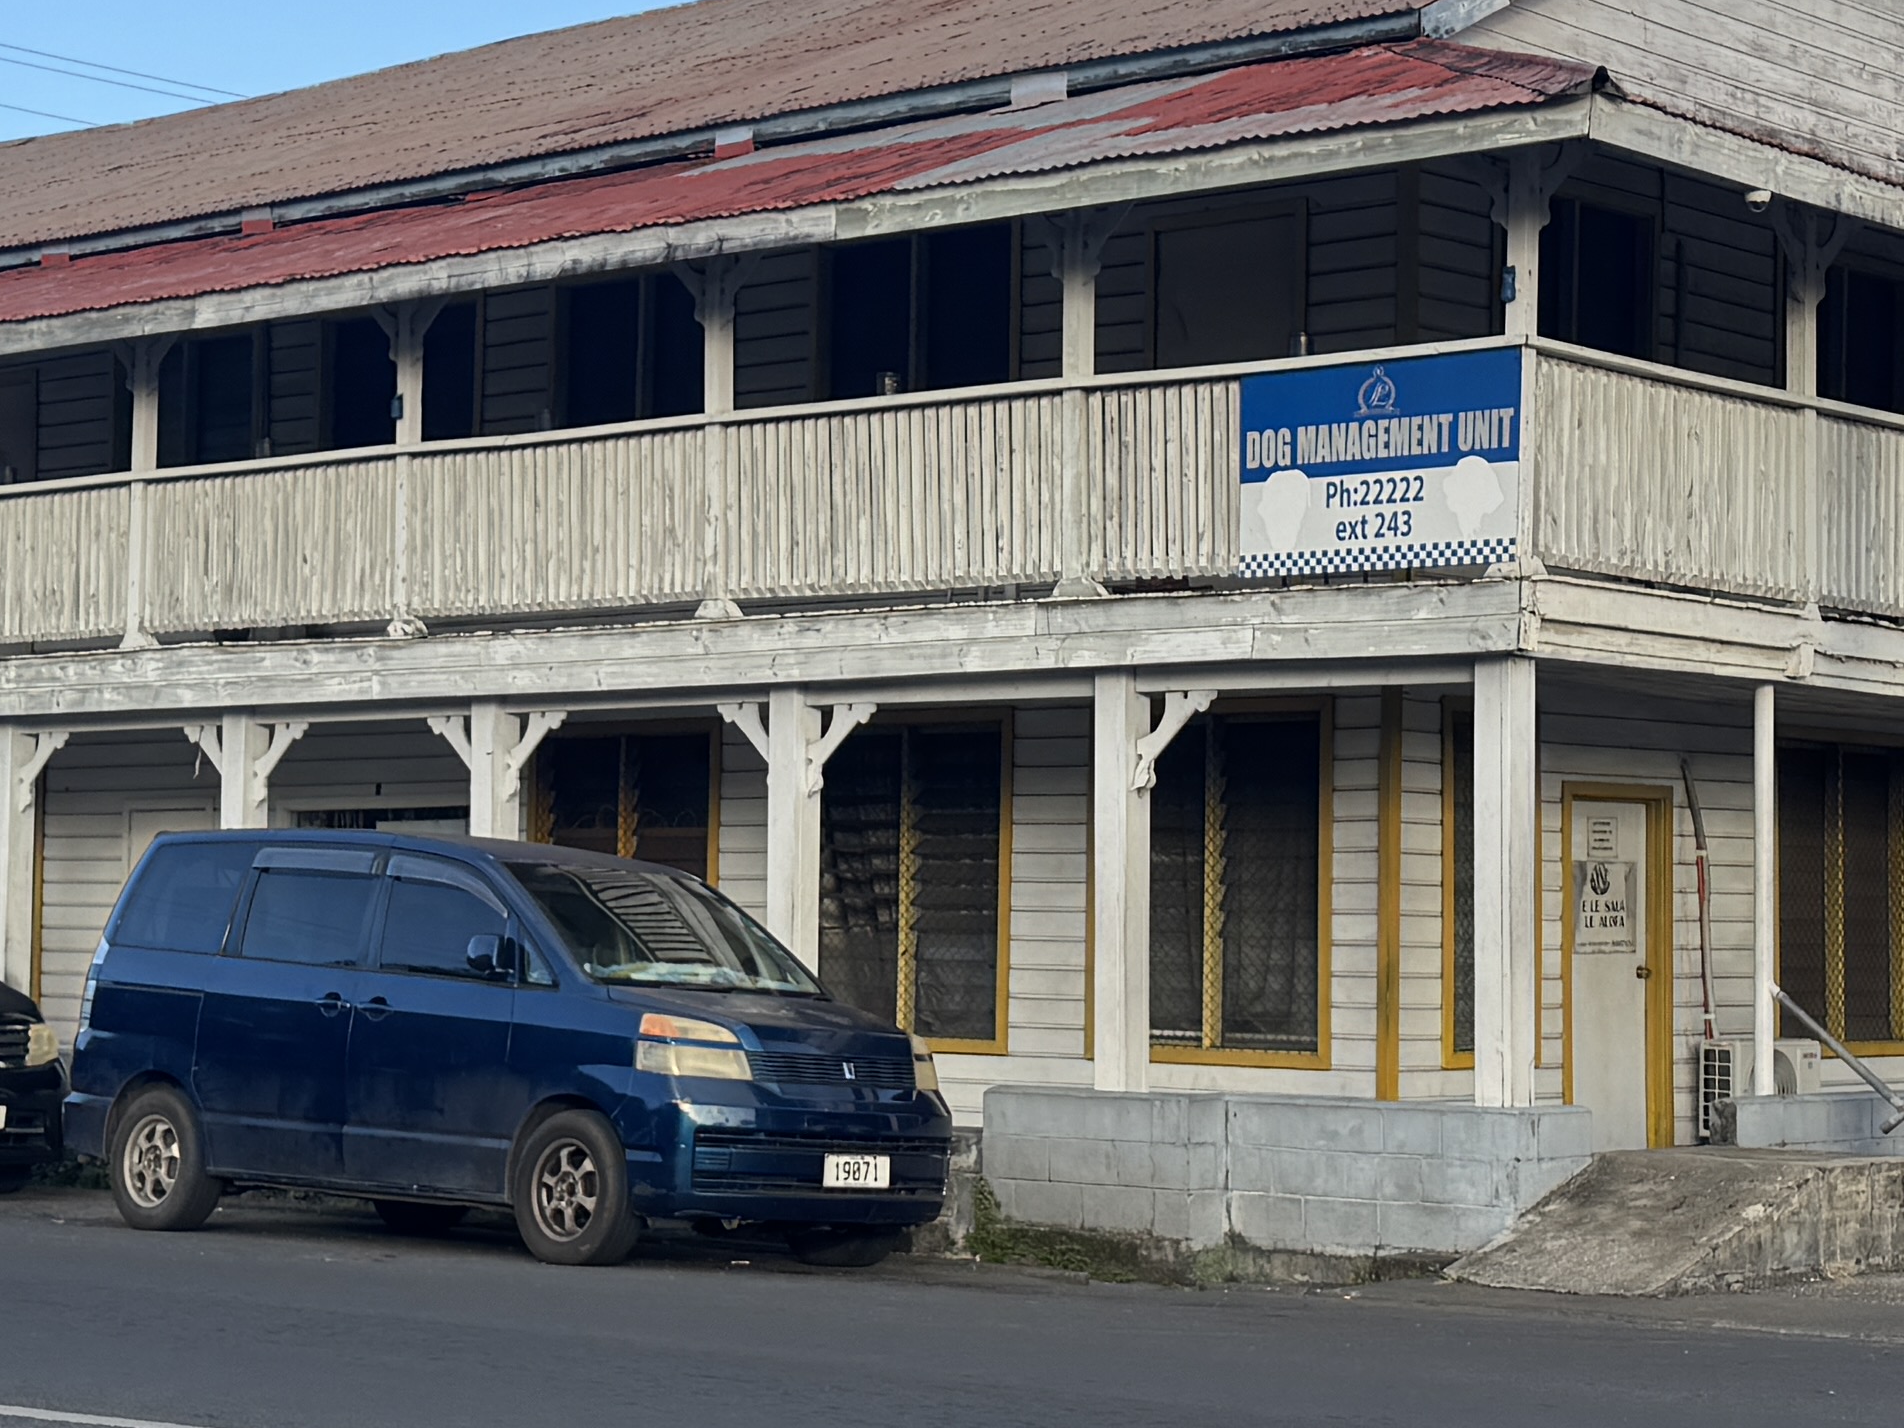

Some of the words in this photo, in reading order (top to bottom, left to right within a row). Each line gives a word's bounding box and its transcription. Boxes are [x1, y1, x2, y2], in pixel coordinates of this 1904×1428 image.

[1246, 427, 1292, 469] DOG
[1296, 412, 1454, 465] MANAGEMENT
[1457, 406, 1515, 452] UNIT
[1325, 474, 1425, 509] Ph:22222
[1335, 514, 1369, 542] ext
[1373, 509, 1413, 539] 243
[835, 1161, 878, 1182] 19071
